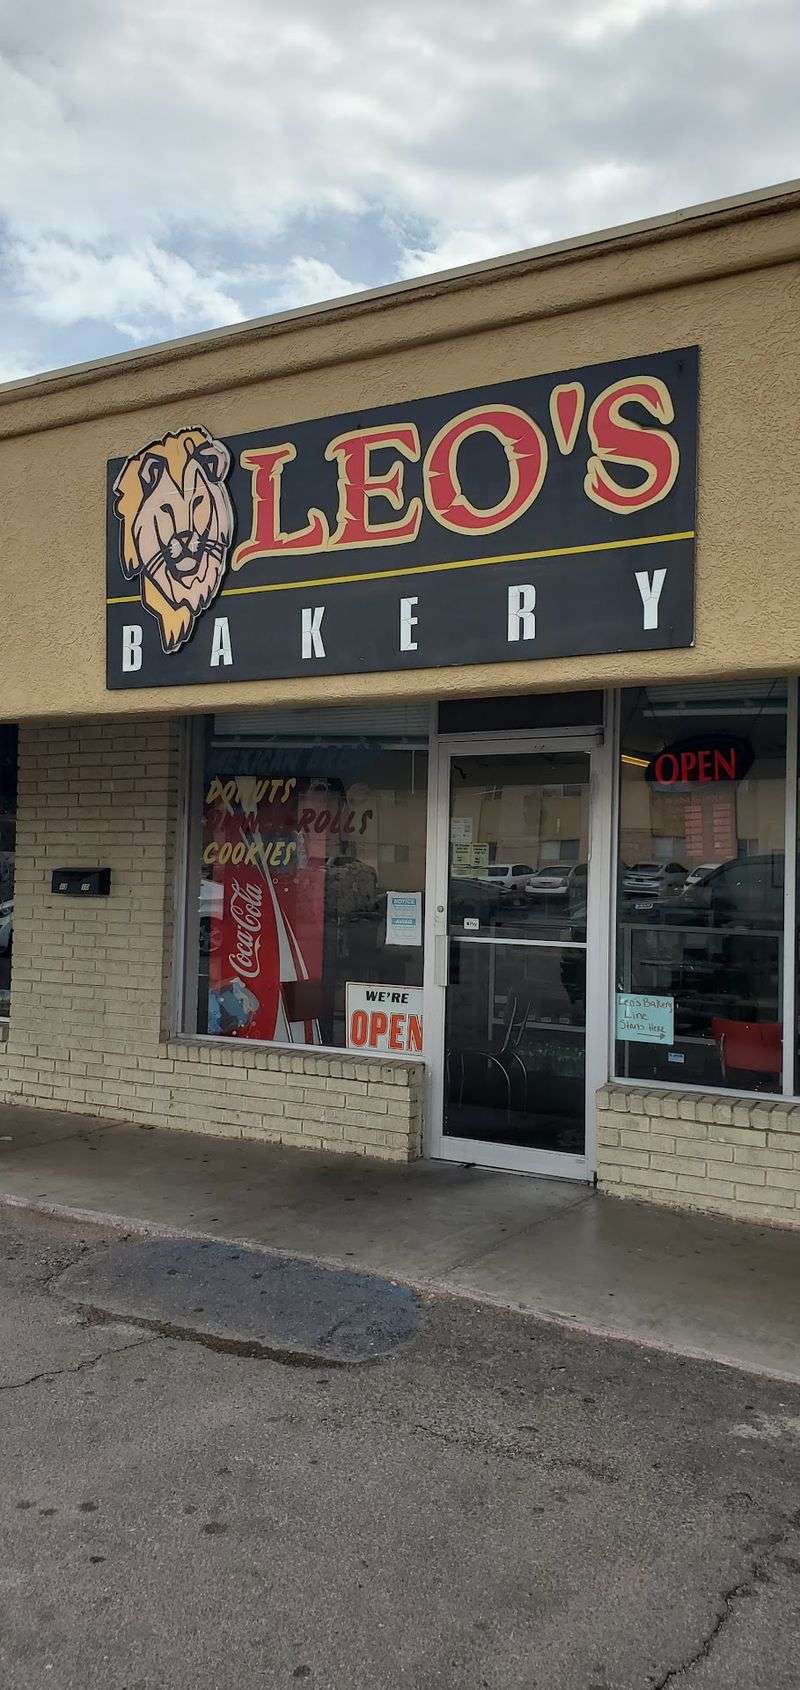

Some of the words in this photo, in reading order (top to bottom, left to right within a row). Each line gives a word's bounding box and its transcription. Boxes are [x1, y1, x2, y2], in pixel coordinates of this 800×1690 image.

[231, 375, 680, 571] LEO'S
[121, 568, 668, 672] BAKERY
[654, 747, 737, 785] OPEN
[297, 808, 373, 835] ROLLS
[202, 841, 297, 866] COOKIES
[366, 990, 409, 1004] WE'RE
[351, 1010, 424, 1052] OPEN
[624, 1010, 649, 1021] Line
